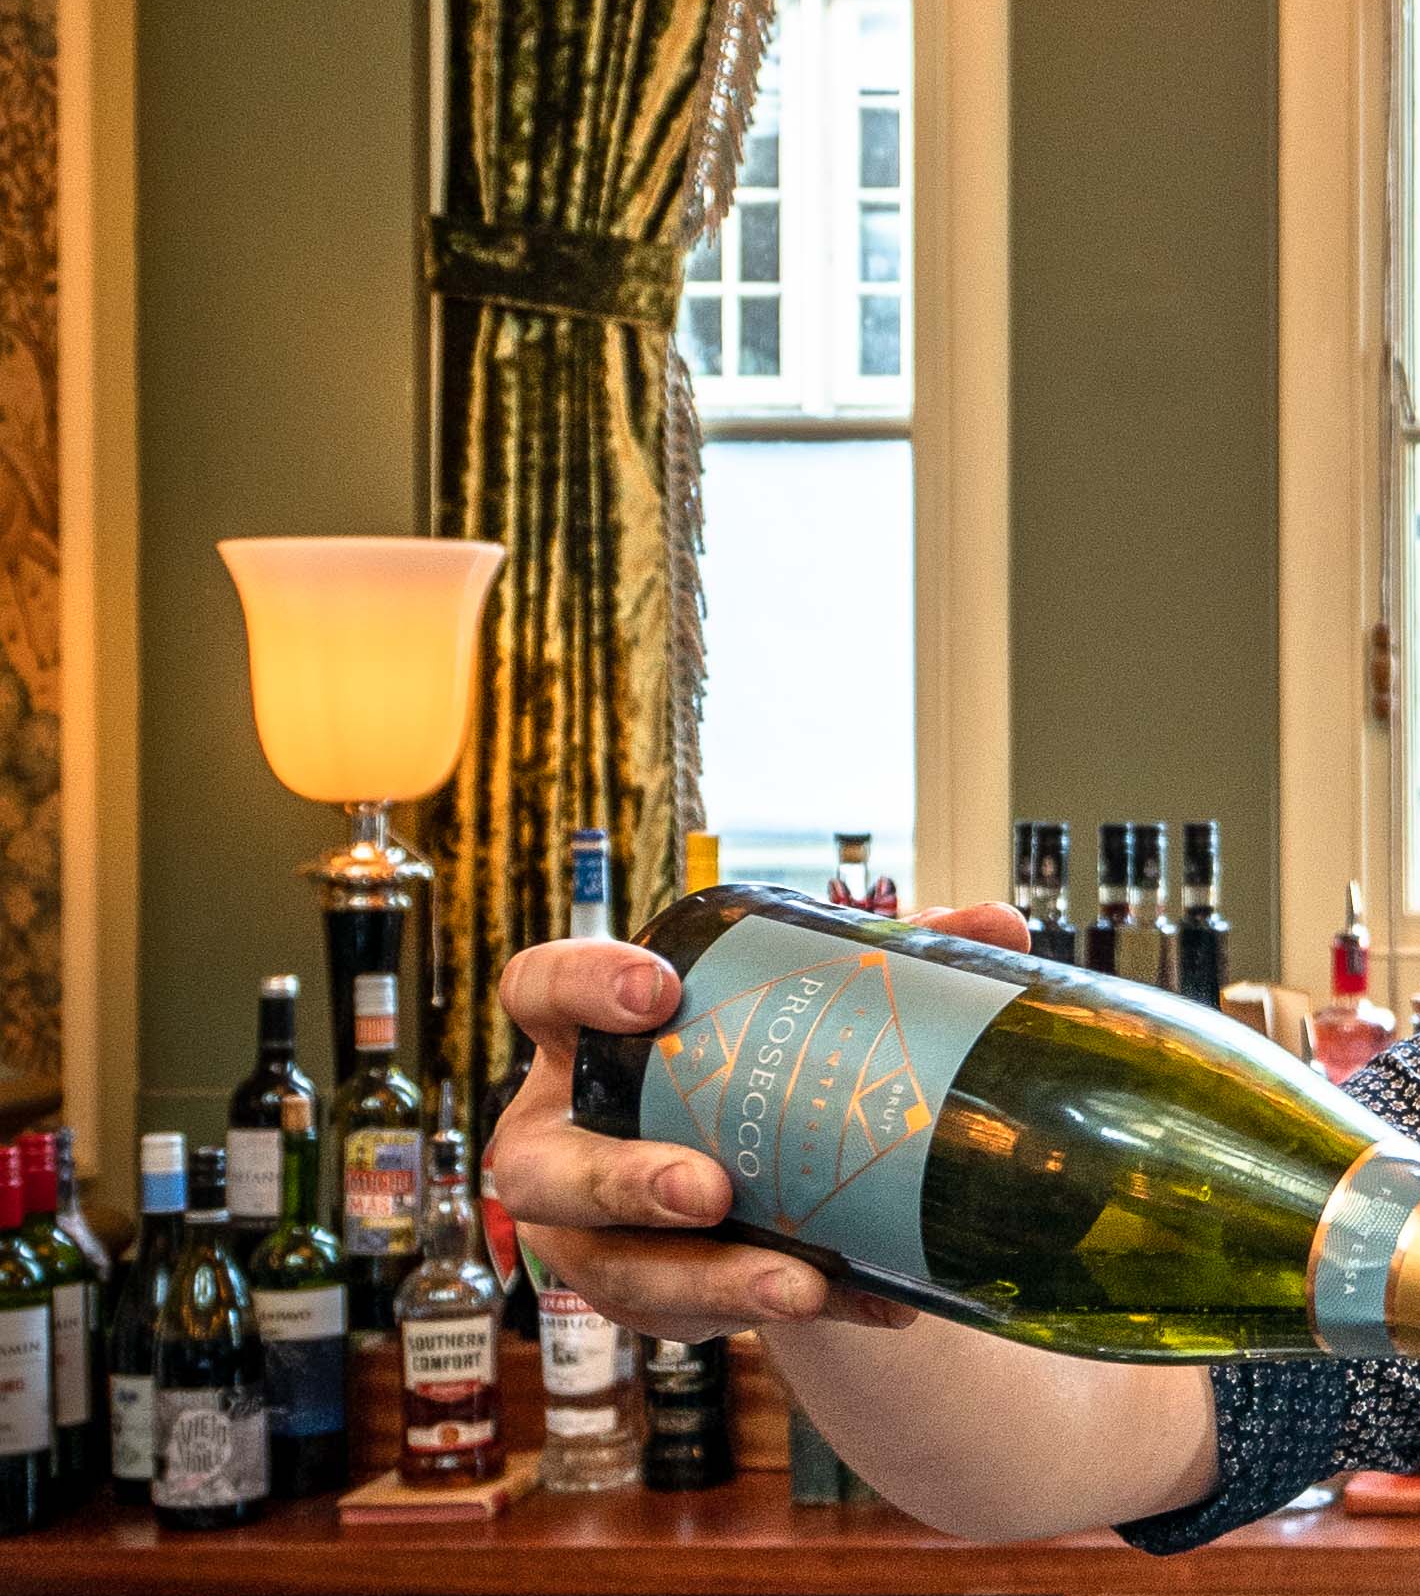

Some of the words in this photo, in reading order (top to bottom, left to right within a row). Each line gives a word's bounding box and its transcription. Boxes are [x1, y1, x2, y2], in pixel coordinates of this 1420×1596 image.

[737, 975, 825, 1180] PROSECCO
[879, 1083, 905, 1135] BRUT
[408, 1331, 487, 1353] SOUTHERN
[411, 1352, 481, 1373] COMFORT
